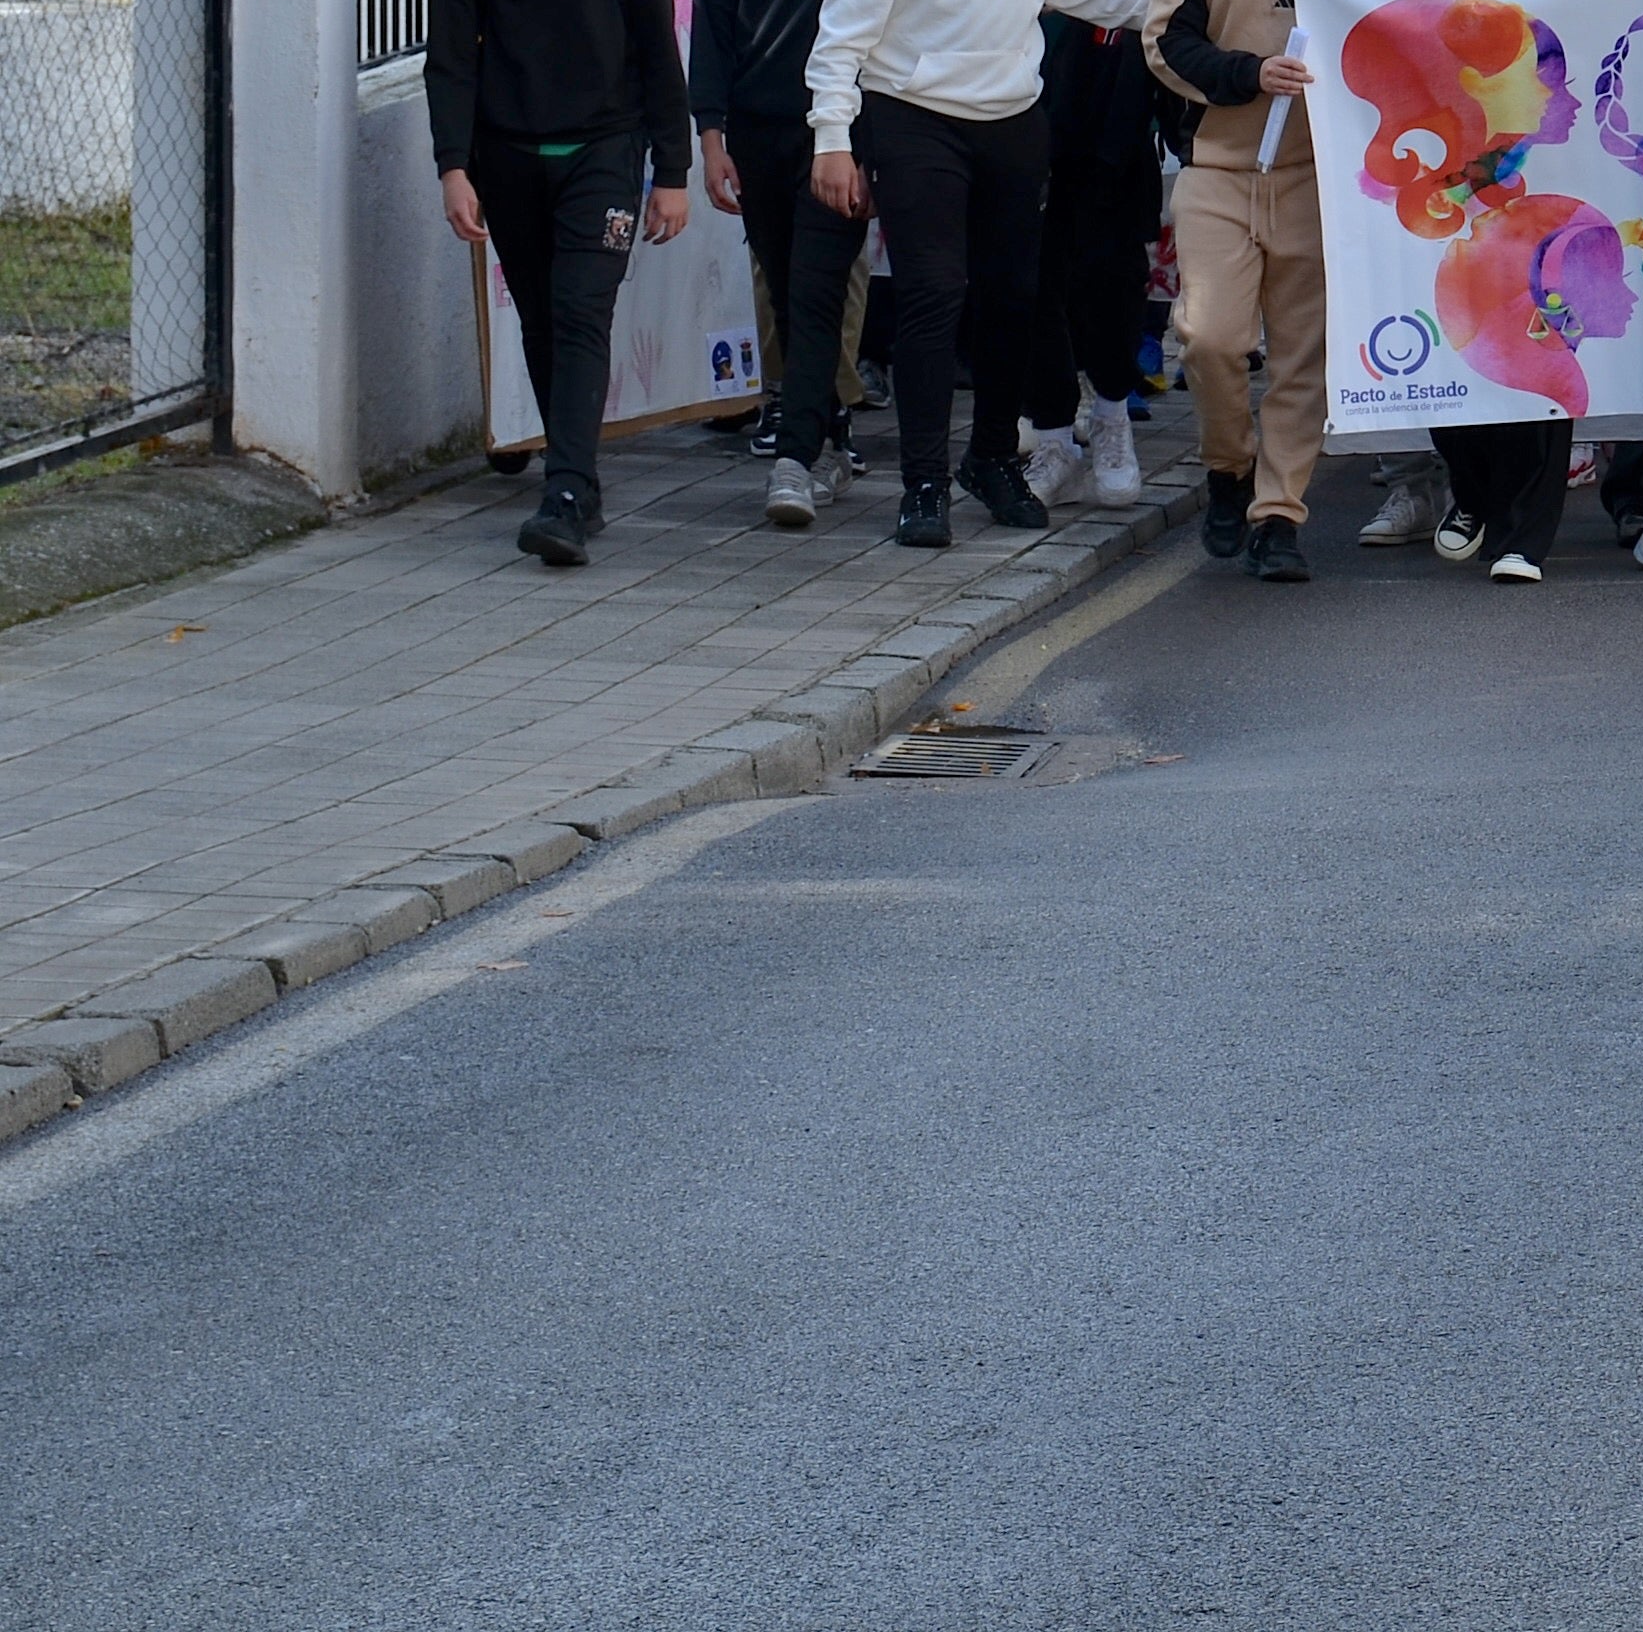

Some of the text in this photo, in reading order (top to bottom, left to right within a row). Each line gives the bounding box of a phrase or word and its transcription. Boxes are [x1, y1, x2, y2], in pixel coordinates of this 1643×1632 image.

[1340, 381, 1468, 404] Pacto de Estado
[1382, 401, 1418, 414] violencia
